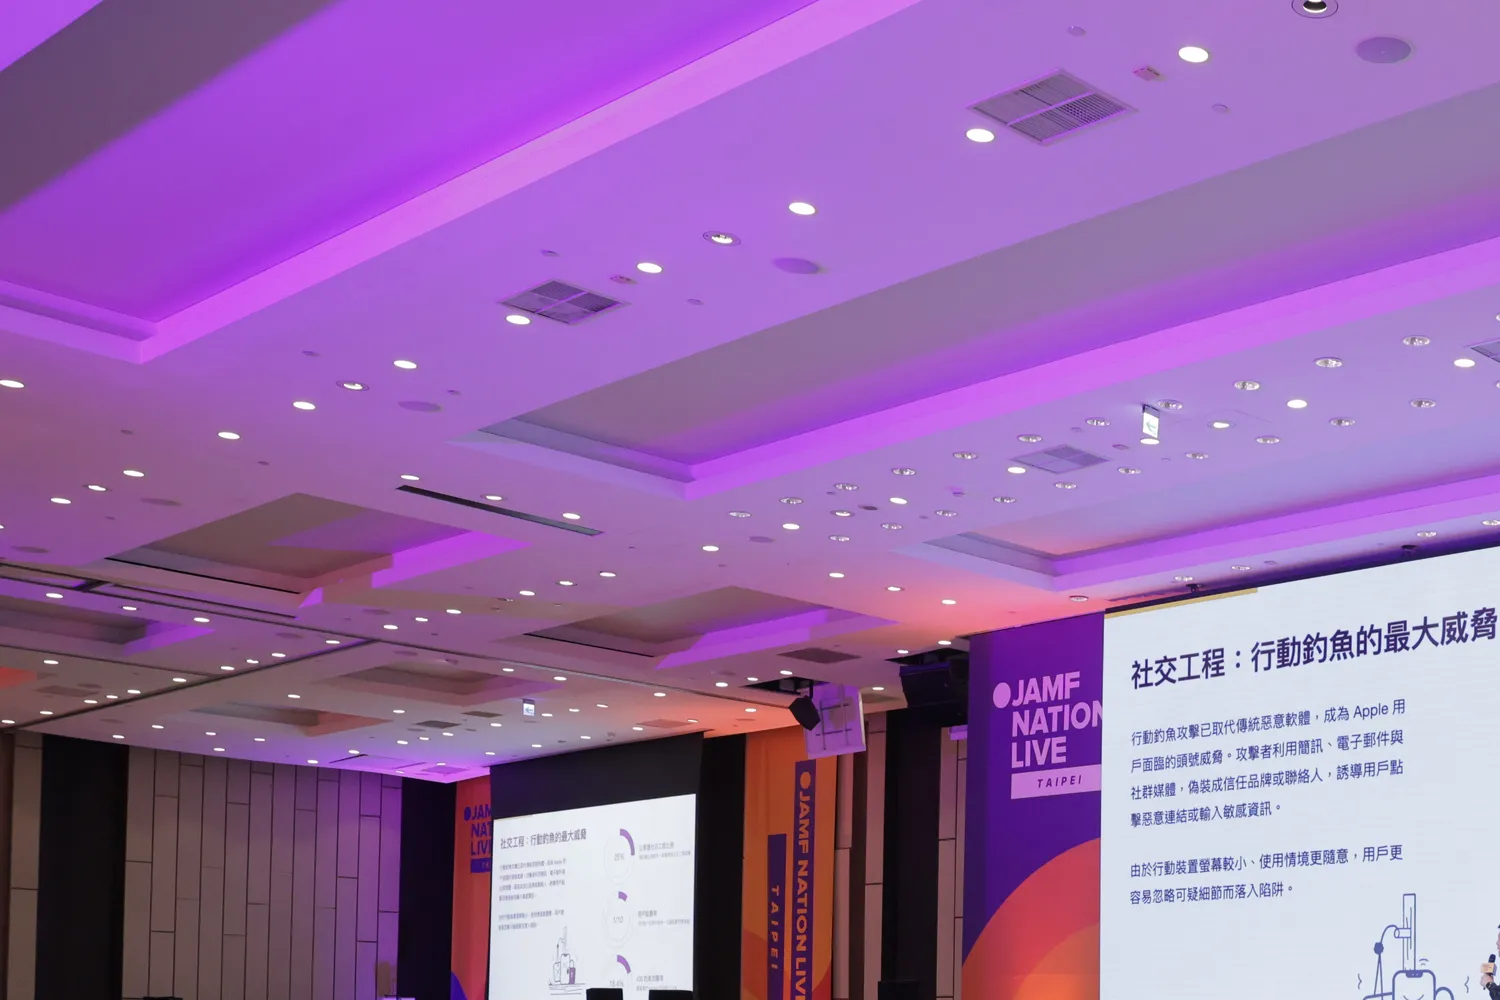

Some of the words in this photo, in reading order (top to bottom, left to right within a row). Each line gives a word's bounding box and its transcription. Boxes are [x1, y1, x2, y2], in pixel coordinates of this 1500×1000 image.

[1131, 607, 1498, 690] 社交工程：行動釣魚的最大威脅
[1012, 671, 1080, 706] JAMF
[1012, 700, 1103, 737] NATION
[1131, 706, 1350, 747] 行動釣魚攻擊已取代傳統惡意軟體，成為
[1353, 703, 1389, 721] Apple
[1392, 698, 1406, 715] 用
[1011, 736, 1067, 769] LIVE
[1130, 729, 1404, 773] 戶面臨的頭號威脅。攻擊者利用簡訊、電子郵件與
[1037, 774, 1083, 789] TAIPEI
[471, 803, 492, 820] JAM
[798, 791, 811, 854] JAMF
[1130, 801, 1281, 828] 擊惡意連結或輸入敏感資訊。
[471, 821, 492, 838] NAT
[471, 840, 491, 856] LIV
[1130, 844, 1404, 878] 由於行動裝置螢幕較小、使用情境更隨意，用戶更
[796, 859, 809, 952] NATION
[1129, 881, 1293, 905] 容易忽略可疑細節而落入陷阱。
[770, 884, 780, 970] TAIPEI
